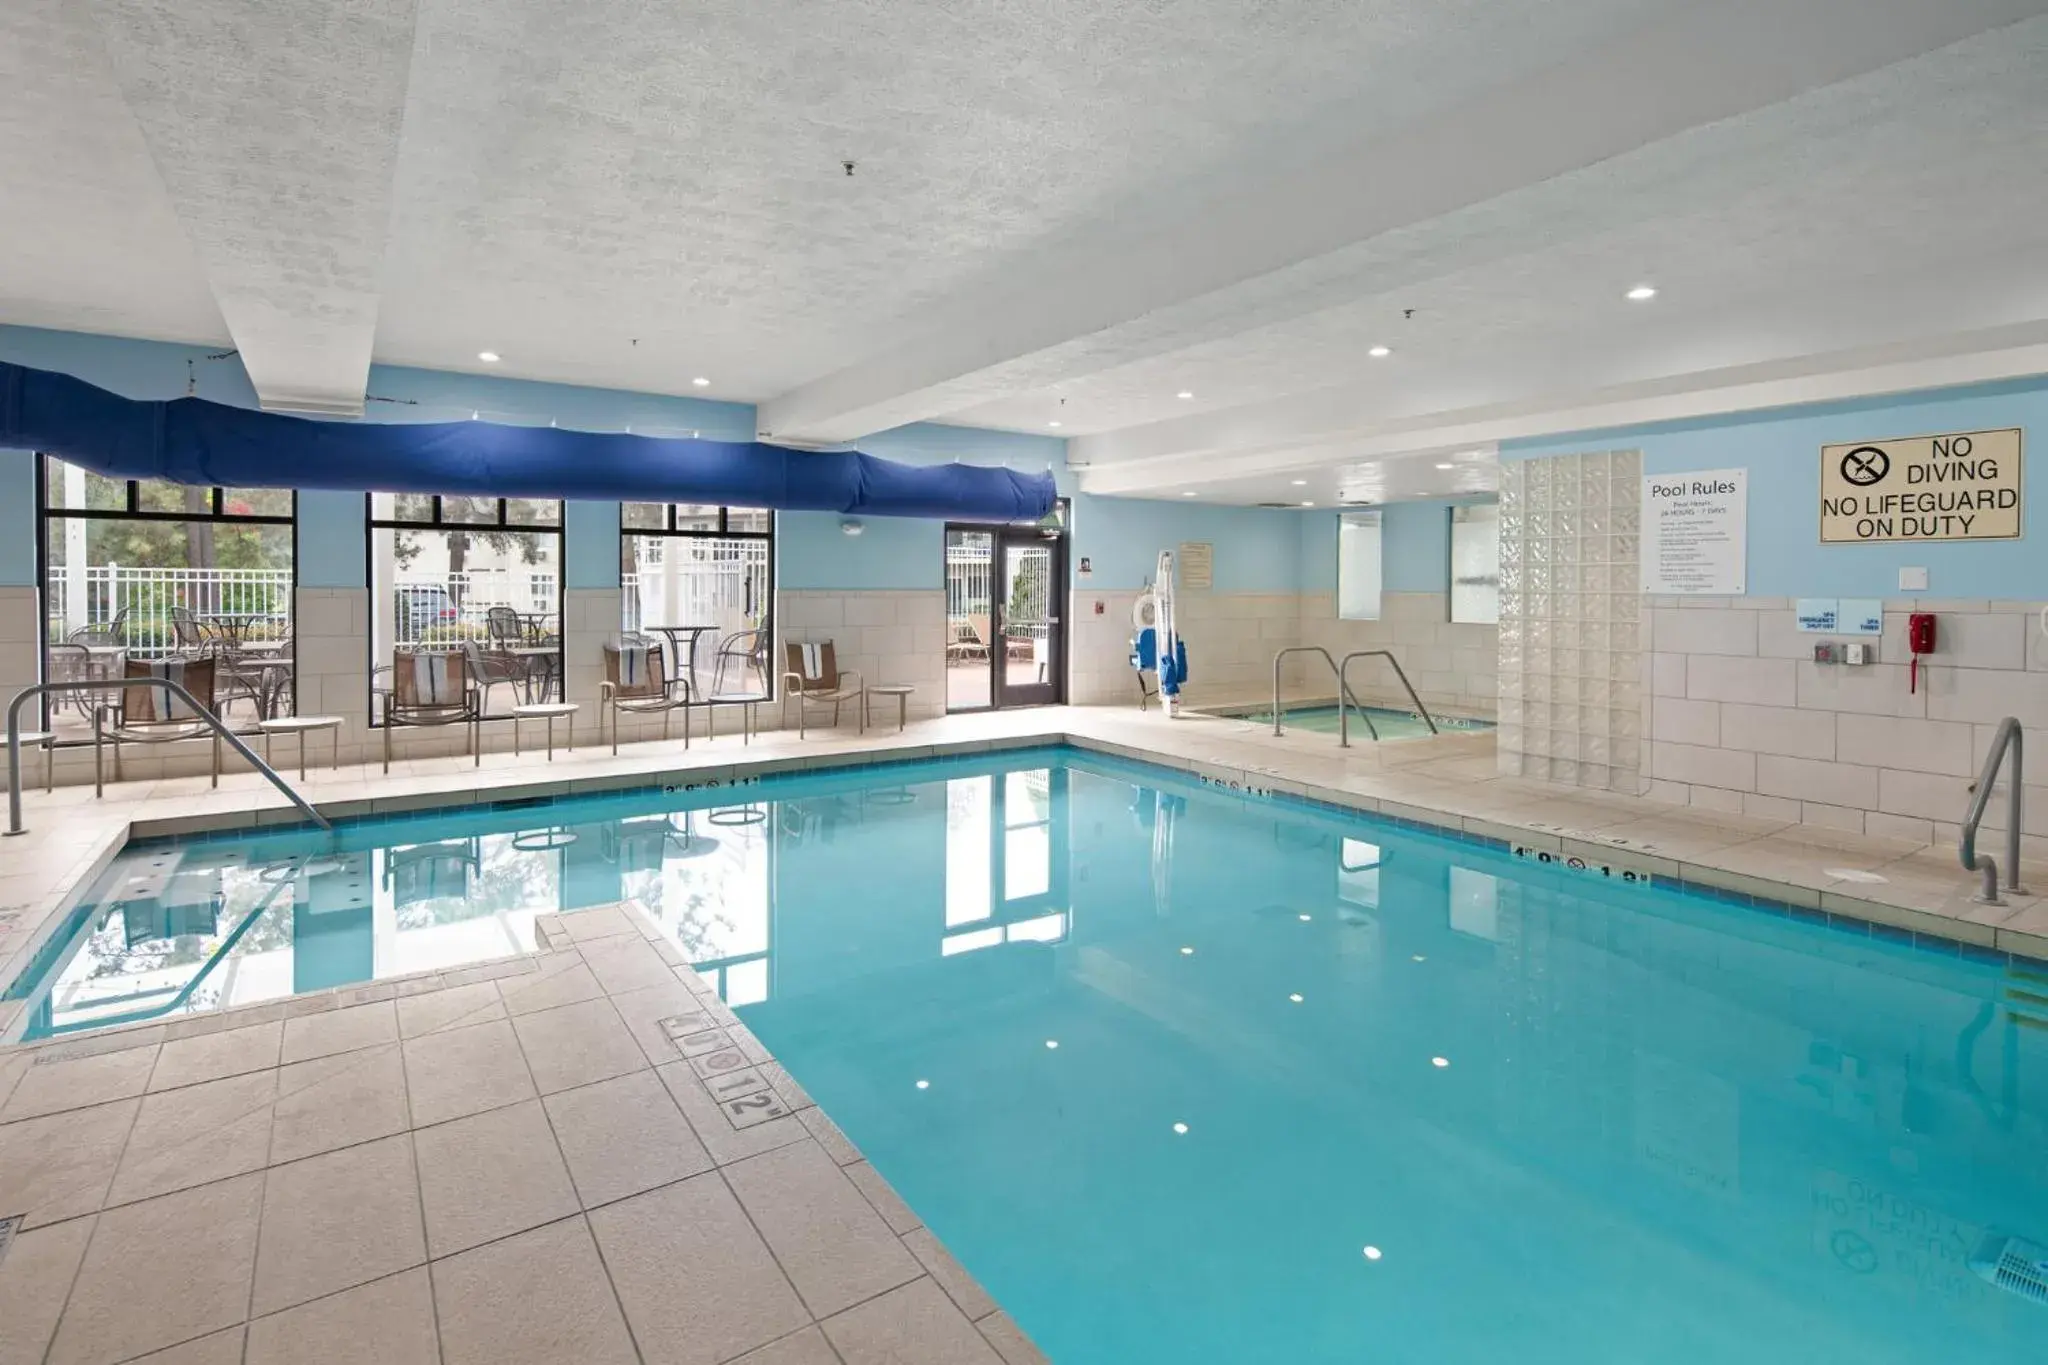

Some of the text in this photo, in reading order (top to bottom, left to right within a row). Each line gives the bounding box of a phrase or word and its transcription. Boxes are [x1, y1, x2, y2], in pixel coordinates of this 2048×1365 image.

[1932, 436, 1973, 459] NO
[1908, 459, 1998, 484] DIVING
[1652, 480, 1736, 498] Pool Rules
[1823, 488, 2017, 517] NO LIFEGUARD
[1856, 515, 1975, 538] ON DUTY
